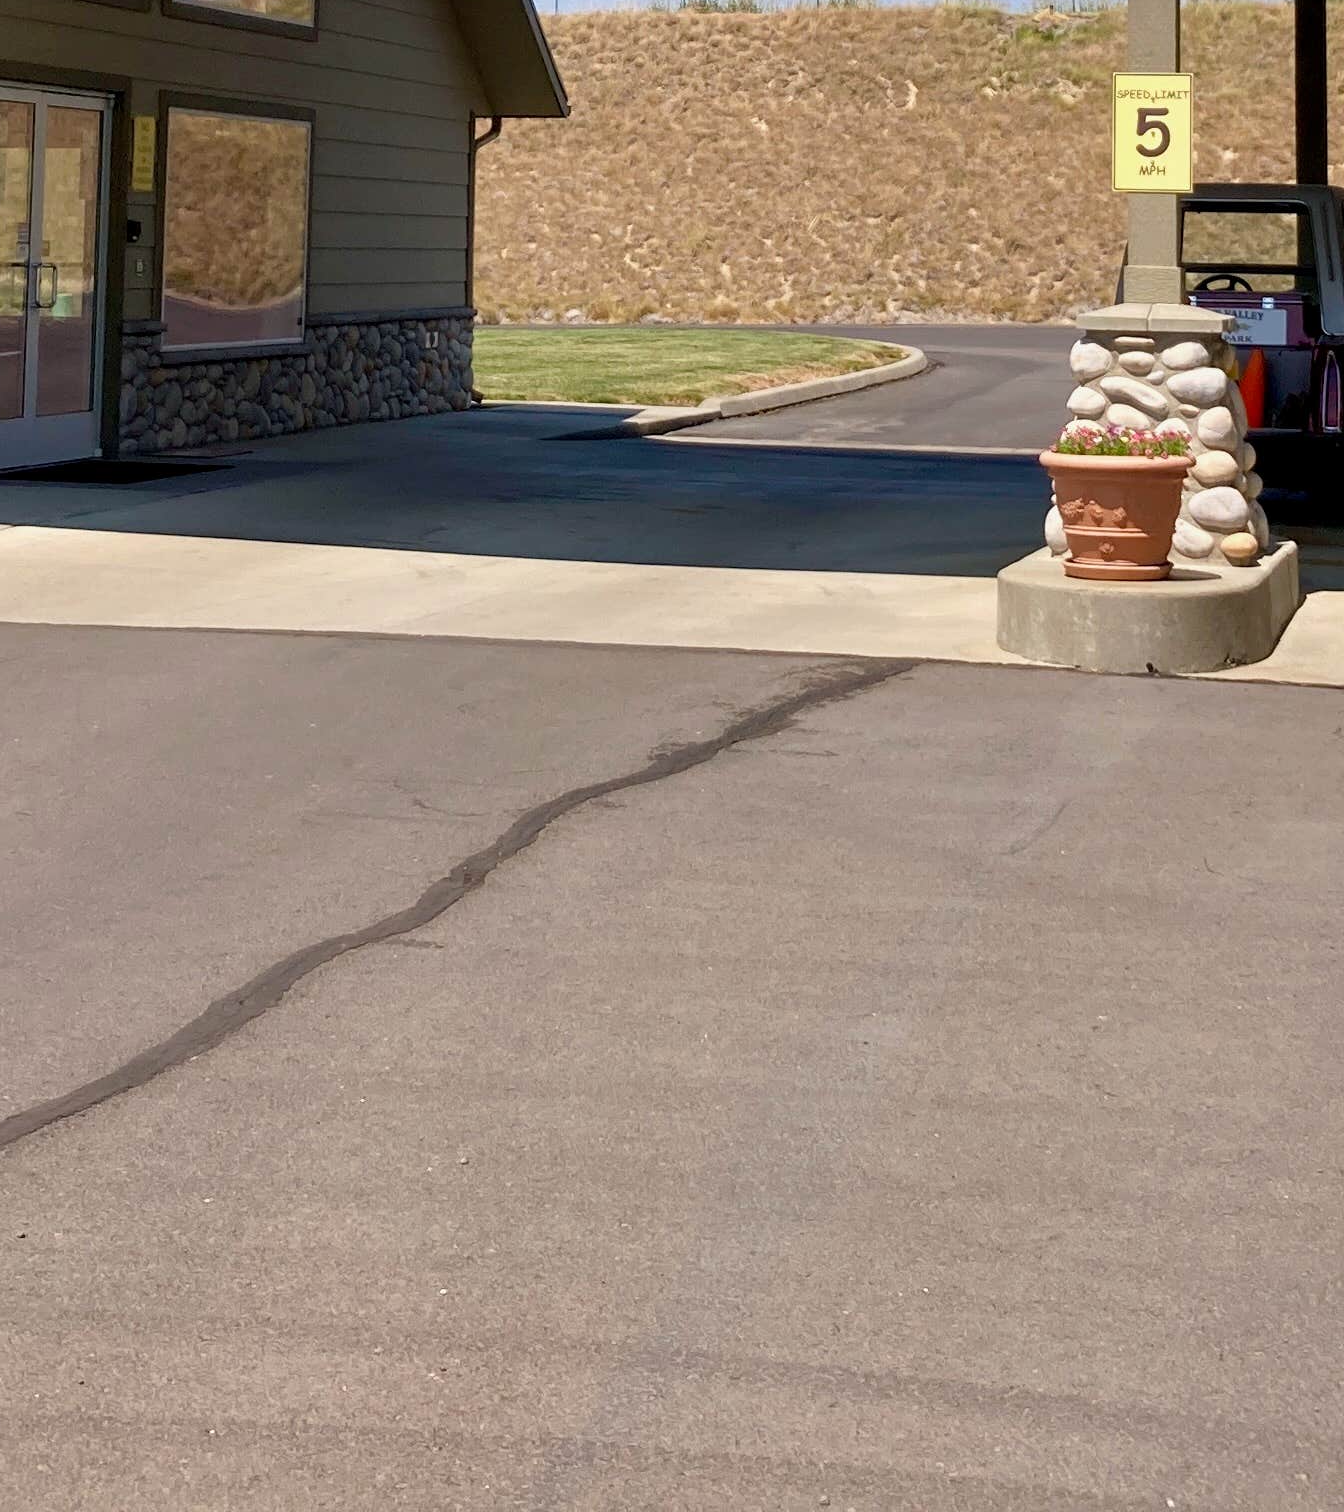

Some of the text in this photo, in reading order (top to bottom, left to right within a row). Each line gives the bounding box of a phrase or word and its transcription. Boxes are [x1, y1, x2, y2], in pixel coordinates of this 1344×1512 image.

[1116, 90, 1190, 99] SPEED LIMIT
[1136, 108, 1170, 157] 5
[1139, 165, 1166, 176] MPH
